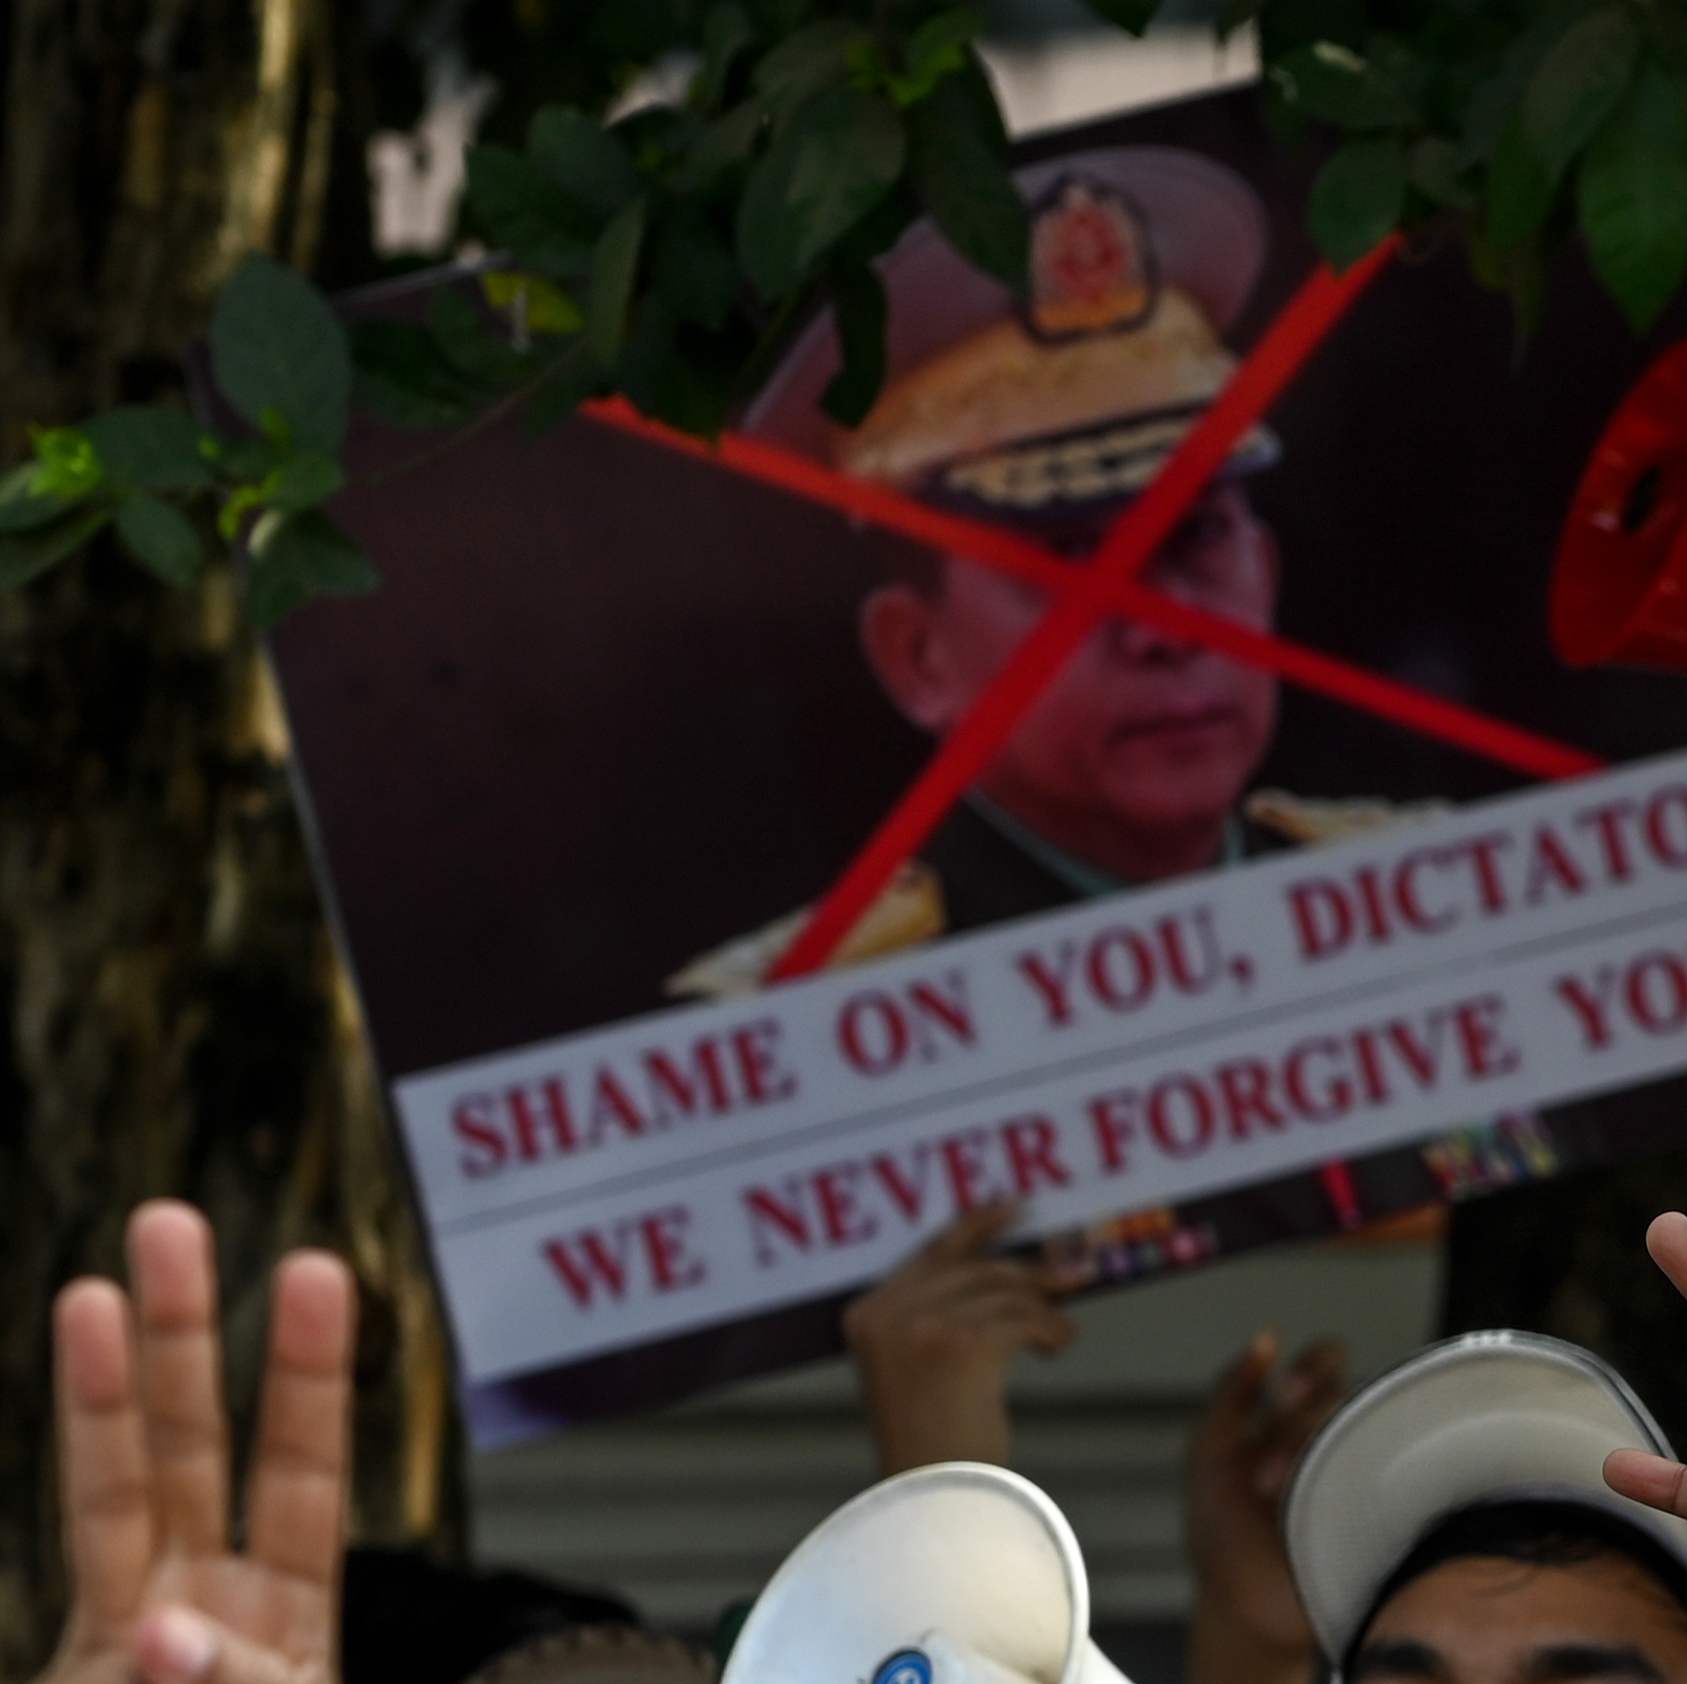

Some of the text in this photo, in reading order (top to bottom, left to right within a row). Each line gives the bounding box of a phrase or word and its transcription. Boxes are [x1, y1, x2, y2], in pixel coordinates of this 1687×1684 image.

[450, 1016, 797, 1185] SHAME
[835, 968, 979, 1080] ON
[1016, 902, 1255, 1031] YOU,
[540, 1204, 706, 1313] WE
[740, 1110, 1072, 1269] NEVER
[1085, 989, 1522, 1177] FORGIVE
